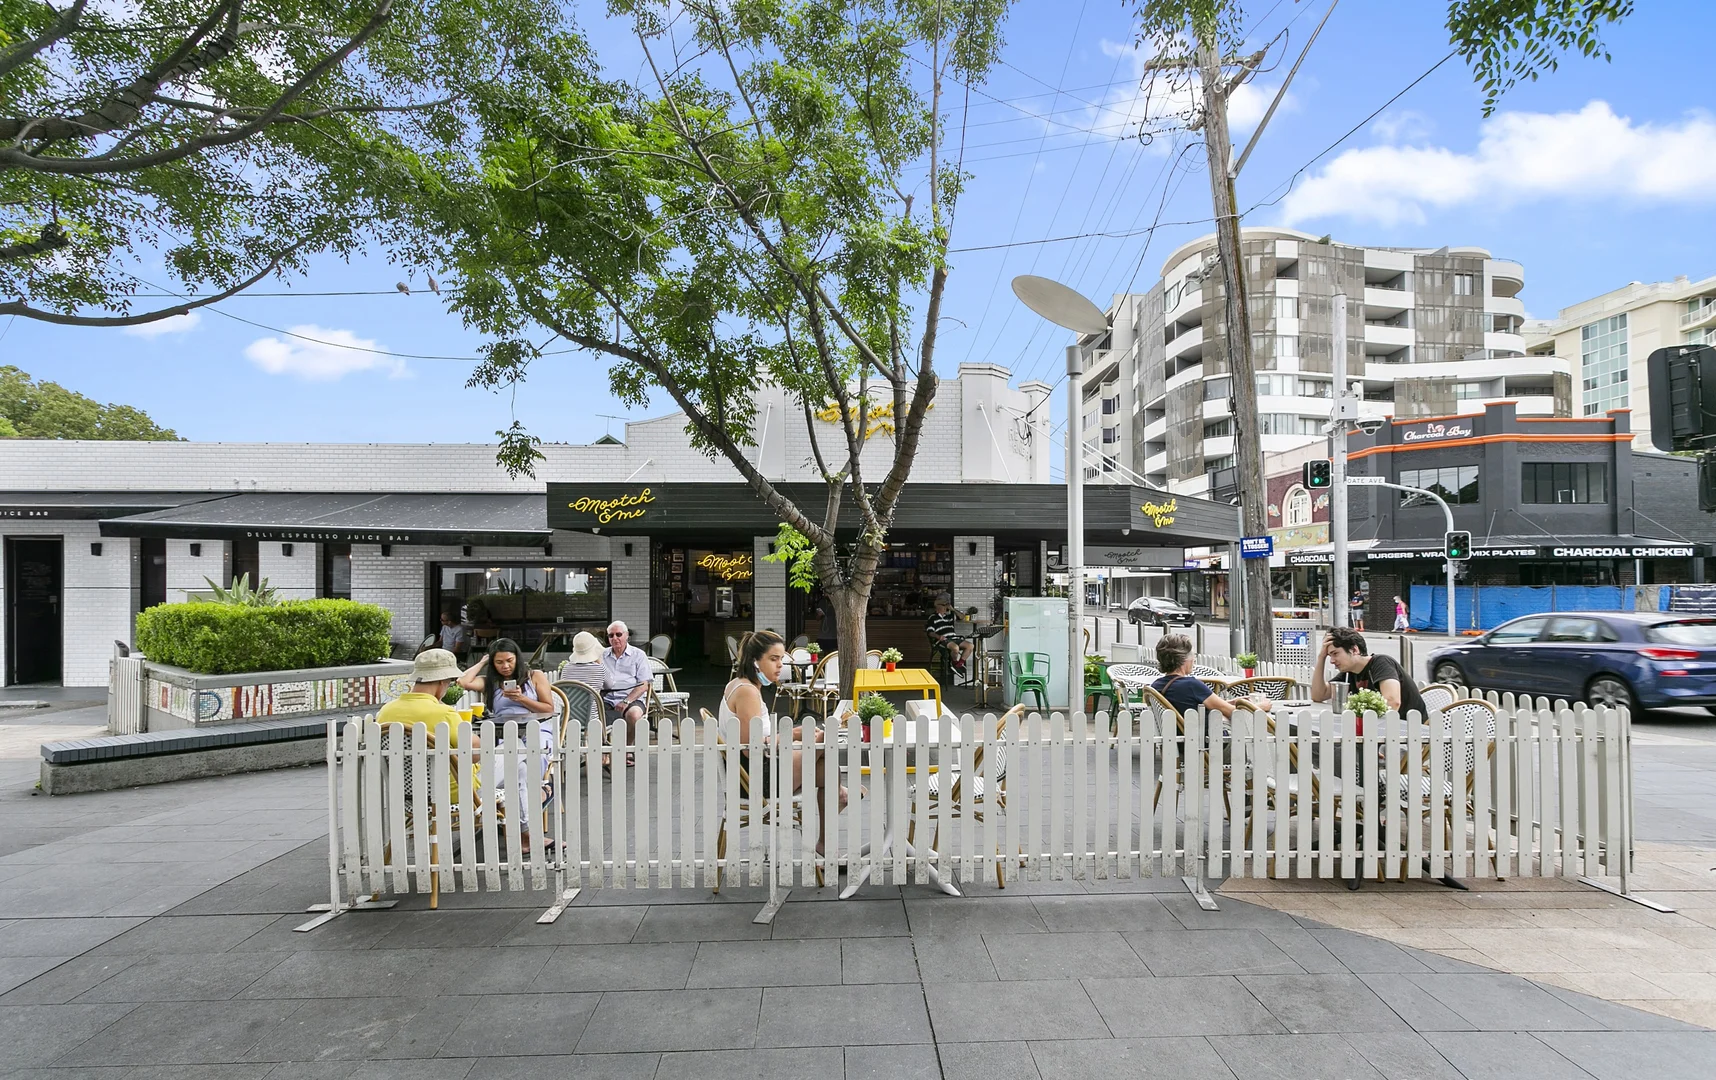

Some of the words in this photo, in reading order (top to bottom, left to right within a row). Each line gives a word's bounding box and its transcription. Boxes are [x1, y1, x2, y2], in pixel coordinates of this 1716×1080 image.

[1403, 428, 1445, 441] Charcoal
[1446, 426, 1472, 437] Bay
[568, 488, 656, 514] Mootch
[1141, 498, 1178, 518] Mootch
[281, 532, 338, 540] ESPRESSO
[1104, 548, 1142, 560] Mootch
[1492, 549, 1537, 557] PLATES
[1553, 547, 1631, 557] CHARCOAL
[1632, 547, 1694, 557] CHICKEN
[1290, 554, 1328, 563] CHARCOAL
